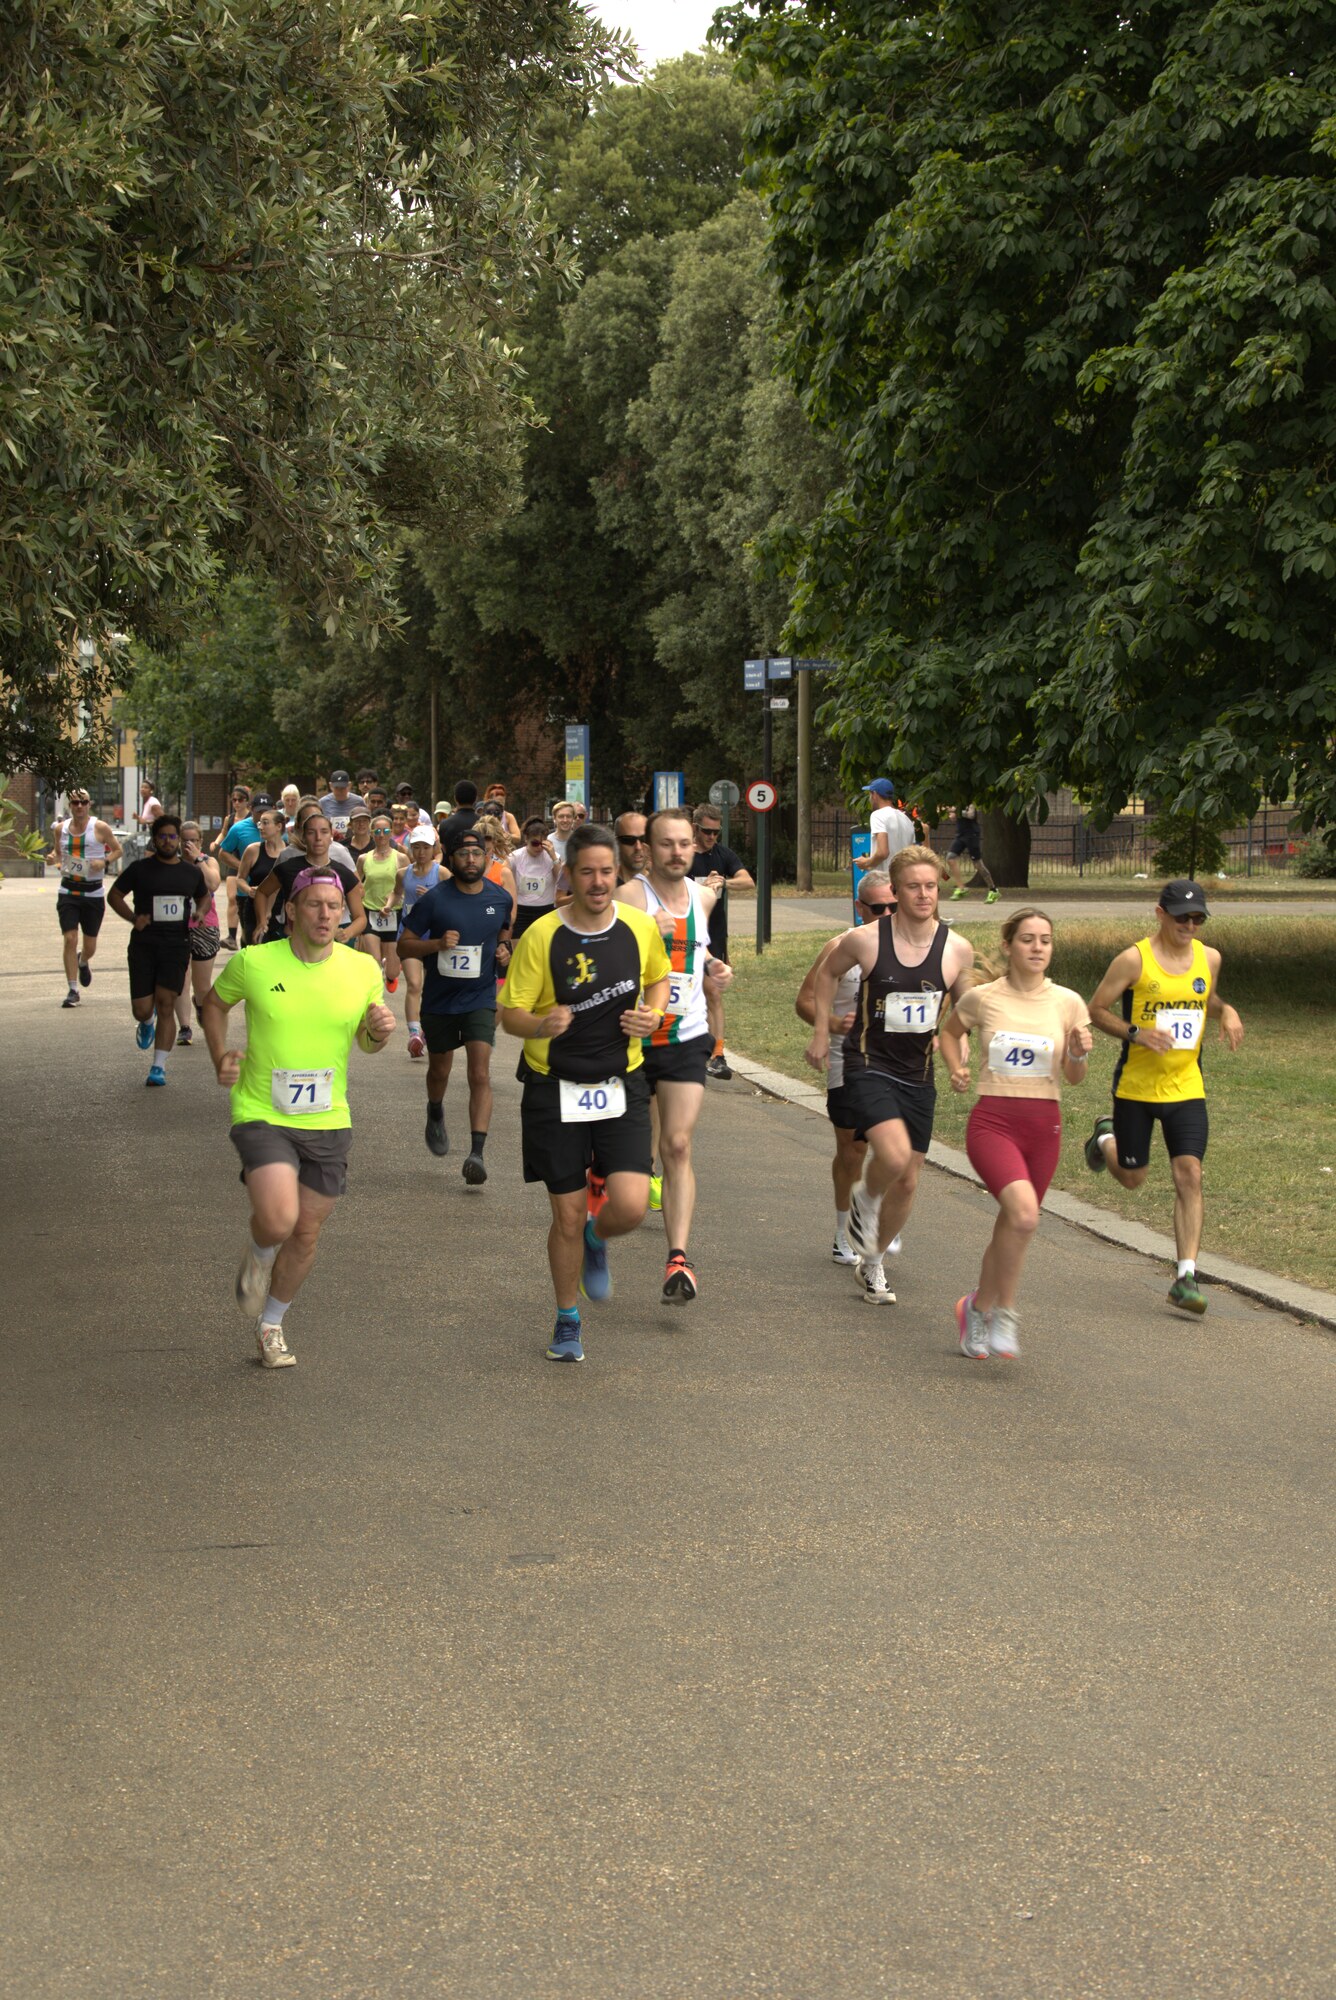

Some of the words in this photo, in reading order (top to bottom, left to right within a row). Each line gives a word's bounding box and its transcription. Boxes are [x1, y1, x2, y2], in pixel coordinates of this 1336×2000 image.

[757, 790, 766, 802] 5
[335, 821, 346, 829] 26
[71, 861, 83, 872] 79
[526, 882, 539, 890] 19
[163, 904, 178, 915] 10
[376, 918, 389, 926] 81
[450, 955, 470, 970] 12
[669, 985, 680, 1004] 5
[1143, 1000, 1205, 1012] LONDON
[902, 1005, 925, 1023] 11
[1171, 1022, 1193, 1039] 18
[1005, 1047, 1035, 1066] 49
[289, 1083, 315, 1104] 71
[578, 1089, 607, 1110] 40
